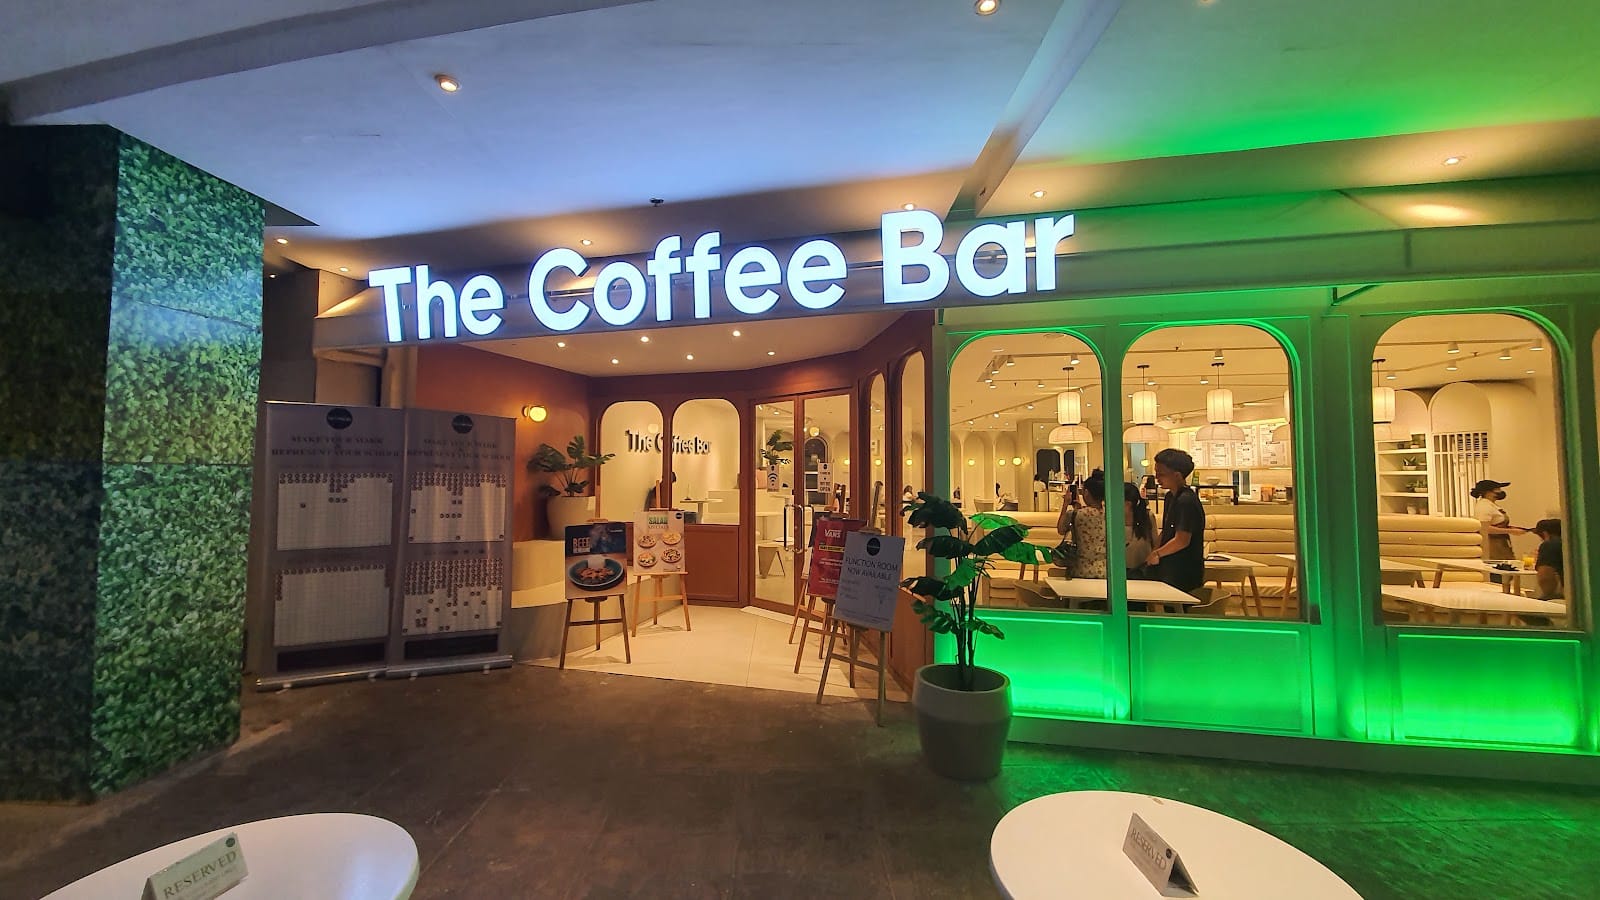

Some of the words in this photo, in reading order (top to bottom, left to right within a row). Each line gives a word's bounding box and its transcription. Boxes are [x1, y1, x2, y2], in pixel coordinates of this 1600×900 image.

[368, 264, 505, 342] The
[528, 231, 848, 331] Coffee
[881, 209, 1075, 304] Bar
[625, 429, 652, 453] The
[572, 536, 591, 548] BEEF
[846, 556, 876, 569] FUNCTION
[877, 562, 898, 572] ROOM
[848, 567, 860, 576] NOW
[861, 570, 892, 580] AVAILABLE
[1130, 827, 1167, 871] RESERVED
[163, 851, 237, 899] RESERVED
